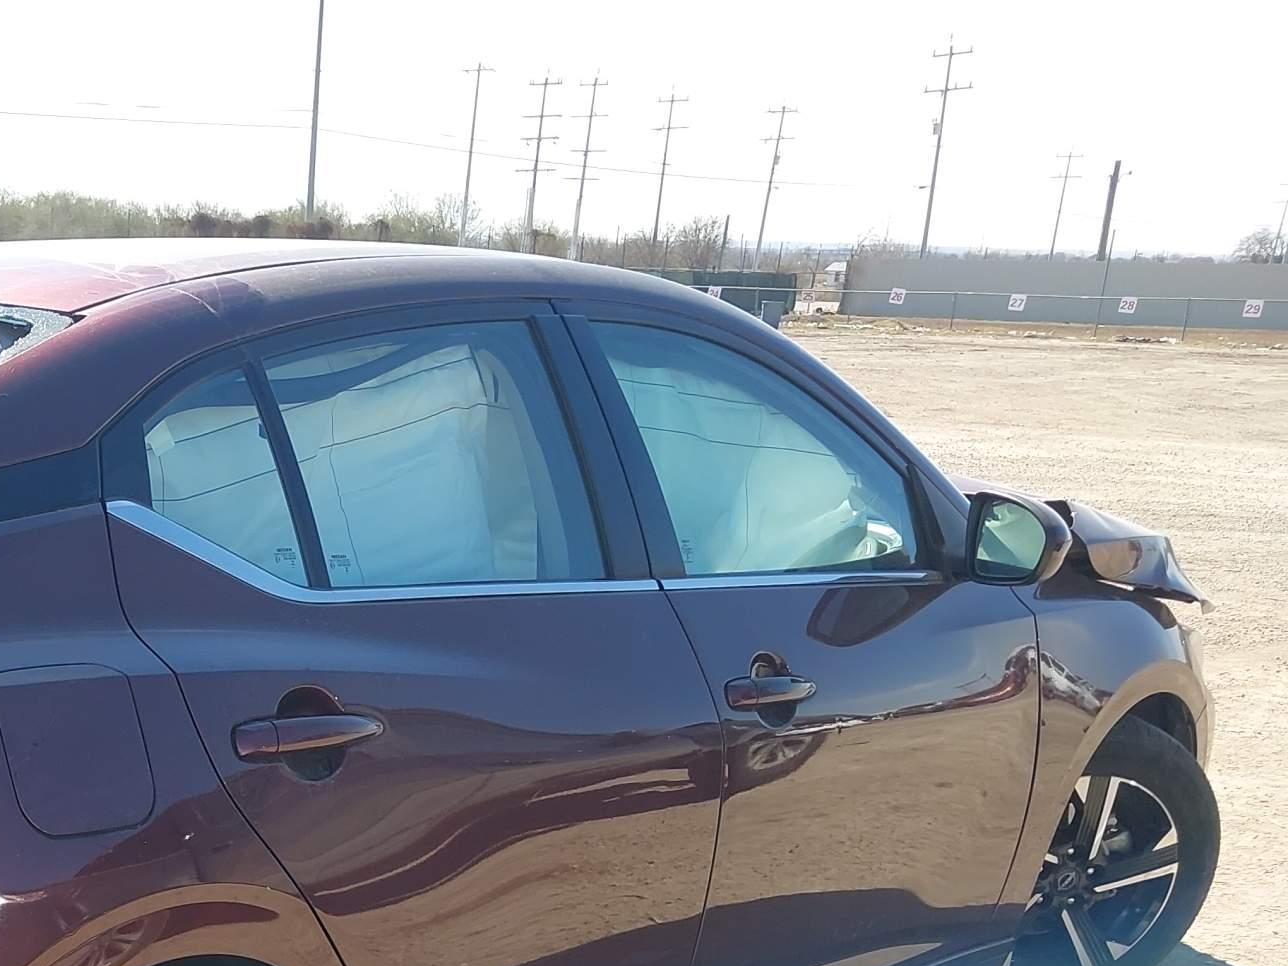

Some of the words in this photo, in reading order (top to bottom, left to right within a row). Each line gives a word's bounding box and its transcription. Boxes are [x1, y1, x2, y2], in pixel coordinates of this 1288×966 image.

[802, 291, 814, 301] 25
[890, 291, 904, 302] 26
[1010, 297, 1025, 308] 27
[1119, 300, 1136, 311] 28
[1245, 303, 1261, 314] 29
